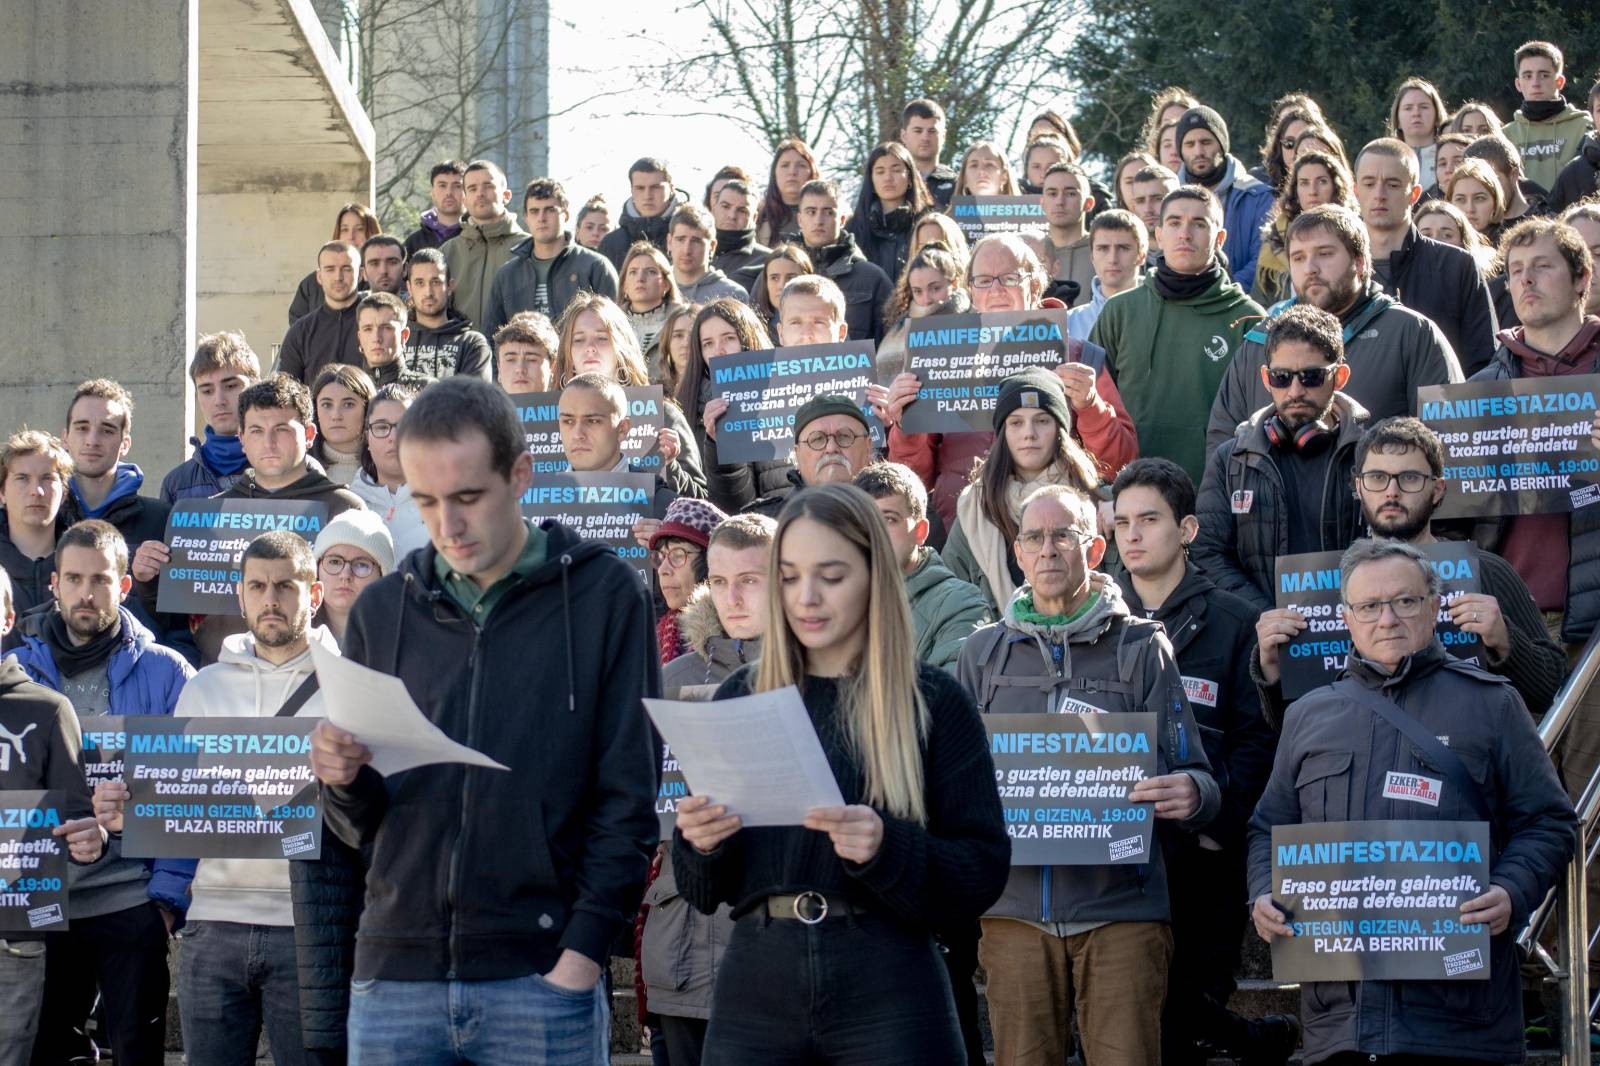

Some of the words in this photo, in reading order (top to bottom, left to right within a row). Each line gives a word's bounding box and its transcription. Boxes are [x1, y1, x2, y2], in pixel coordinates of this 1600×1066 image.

[955, 204, 1046, 217] MANIFESTAZI
[1020, 221, 1050, 231] gainet
[908, 324, 1063, 348] MANIFESTAZIOA
[911, 356, 947, 369] Eraso
[950, 353, 1000, 369] guztien
[1003, 350, 1063, 366] gainetik,
[715, 353, 872, 384] MANIFESTAZIOA
[928, 368, 972, 380] txozna
[722, 390, 758, 403] Eraso
[762, 383, 811, 399] guztien
[814, 375, 873, 393] gainetik,
[973, 385, 1000, 398] GIZE
[740, 398, 785, 413] txozna
[937, 400, 978, 412] PLAZA
[1422, 391, 1597, 421] MANIFESTAZIOA
[724, 416, 784, 432] OSTEGUN
[752, 427, 794, 442] PLAZA
[1472, 426, 1528, 444] guztien
[530, 444, 565, 455] txozn
[1449, 444, 1498, 458] txozna
[1502, 438, 1578, 455] defendatu
[531, 460, 571, 473] TEGUN
[1442, 464, 1496, 481] STEGUN
[1500, 460, 1555, 477] GIZENA,
[1558, 458, 1599, 474] 19:00
[1461, 479, 1507, 494] PLAZA
[1511, 474, 1571, 491] BERRITIK
[520, 487, 648, 505] NIFESTAZIOA
[171, 511, 321, 532] MANIFESTAZIOA
[171, 536, 207, 549] Eraso
[210, 537, 250, 551] guztie
[187, 550, 230, 563] txozna
[613, 547, 647, 559] 9:00
[169, 568, 226, 581] OSTEGUN
[193, 581, 233, 595] PLAZA
[1309, 618, 1348, 633] txoz
[1289, 640, 1350, 657] OSTEGU
[131, 734, 312, 754] MANIFESTAZIOA
[991, 732, 1149, 753] NIFESTAZIOA
[133, 764, 178, 779] Eraso
[182, 764, 241, 781] guztien
[245, 766, 316, 783] gainetik,
[1007, 766, 1070, 784] guztien
[1075, 765, 1148, 784] gainetik,
[155, 781, 208, 795] txozna
[211, 781, 295, 796] defendatu
[999, 785, 1034, 798] ozna
[1039, 783, 1126, 798] defendatu
[134, 804, 200, 818] OSTEGUN
[208, 804, 266, 820] GIZENA,
[273, 806, 316, 819] 19:00
[1034, 808, 1096, 823] GIZENA,
[1103, 808, 1147, 822] 19:00
[165, 820, 214, 833] PLAZA
[218, 820, 284, 834] BERRITIK
[1007, 825, 1038, 838] AZA
[1042, 824, 1113, 838] BERRITIK
[0, 838, 60, 855] ainetik,
[1277, 841, 1482, 867] MANIFESTAZIOA
[17, 878, 62, 891] 19:00
[1281, 878, 1326, 895] Eraso
[1330, 876, 1397, 895] guztien
[1401, 875, 1481, 895] gainetik,
[1303, 896, 1358, 911] txozna
[1363, 893, 1458, 909] defendatu
[1359, 919, 1427, 936] GIZENA,
[1314, 937, 1365, 953] PLAZA
[1369, 936, 1446, 952] BERRITIK
